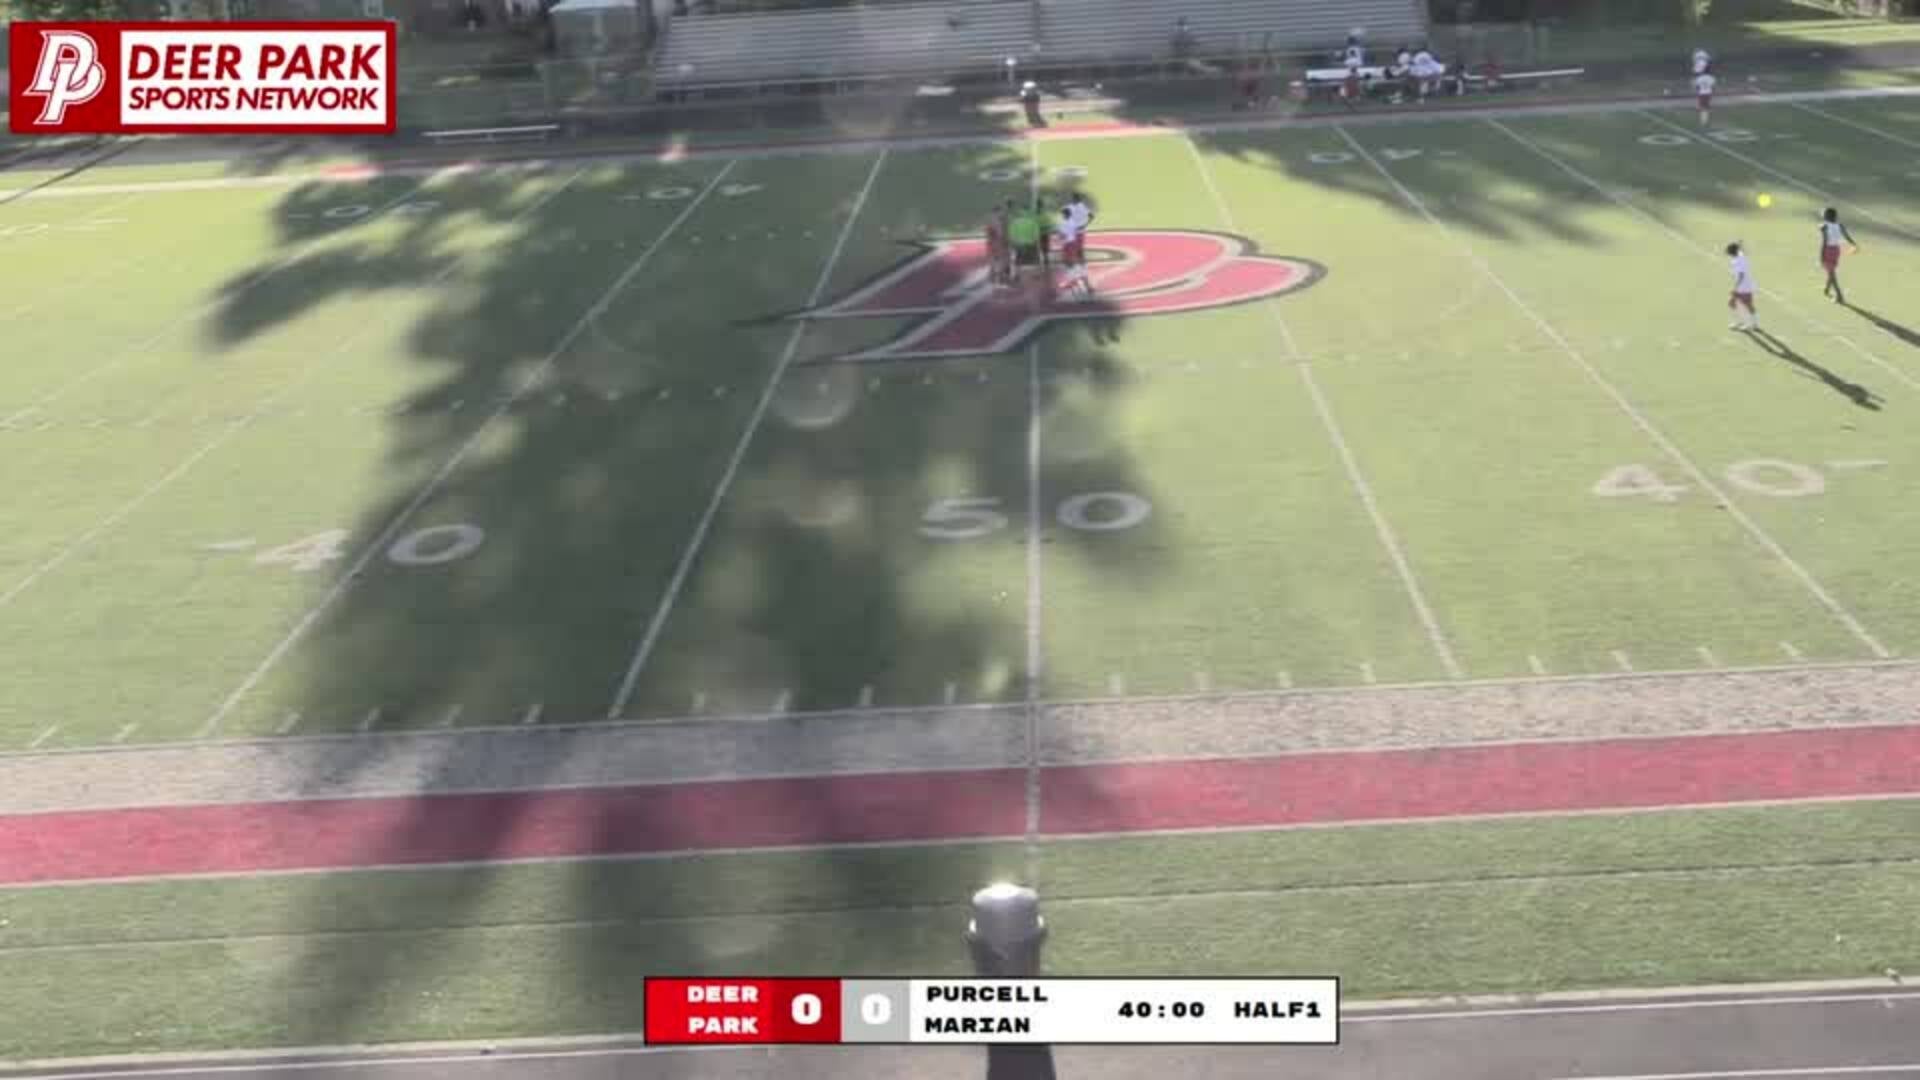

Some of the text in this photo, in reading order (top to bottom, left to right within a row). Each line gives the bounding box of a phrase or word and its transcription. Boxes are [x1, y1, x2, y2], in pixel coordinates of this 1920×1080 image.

[1592, 459, 1825, 503] 40
[920, 489, 1152, 540] 50
[255, 522, 485, 572] 40
